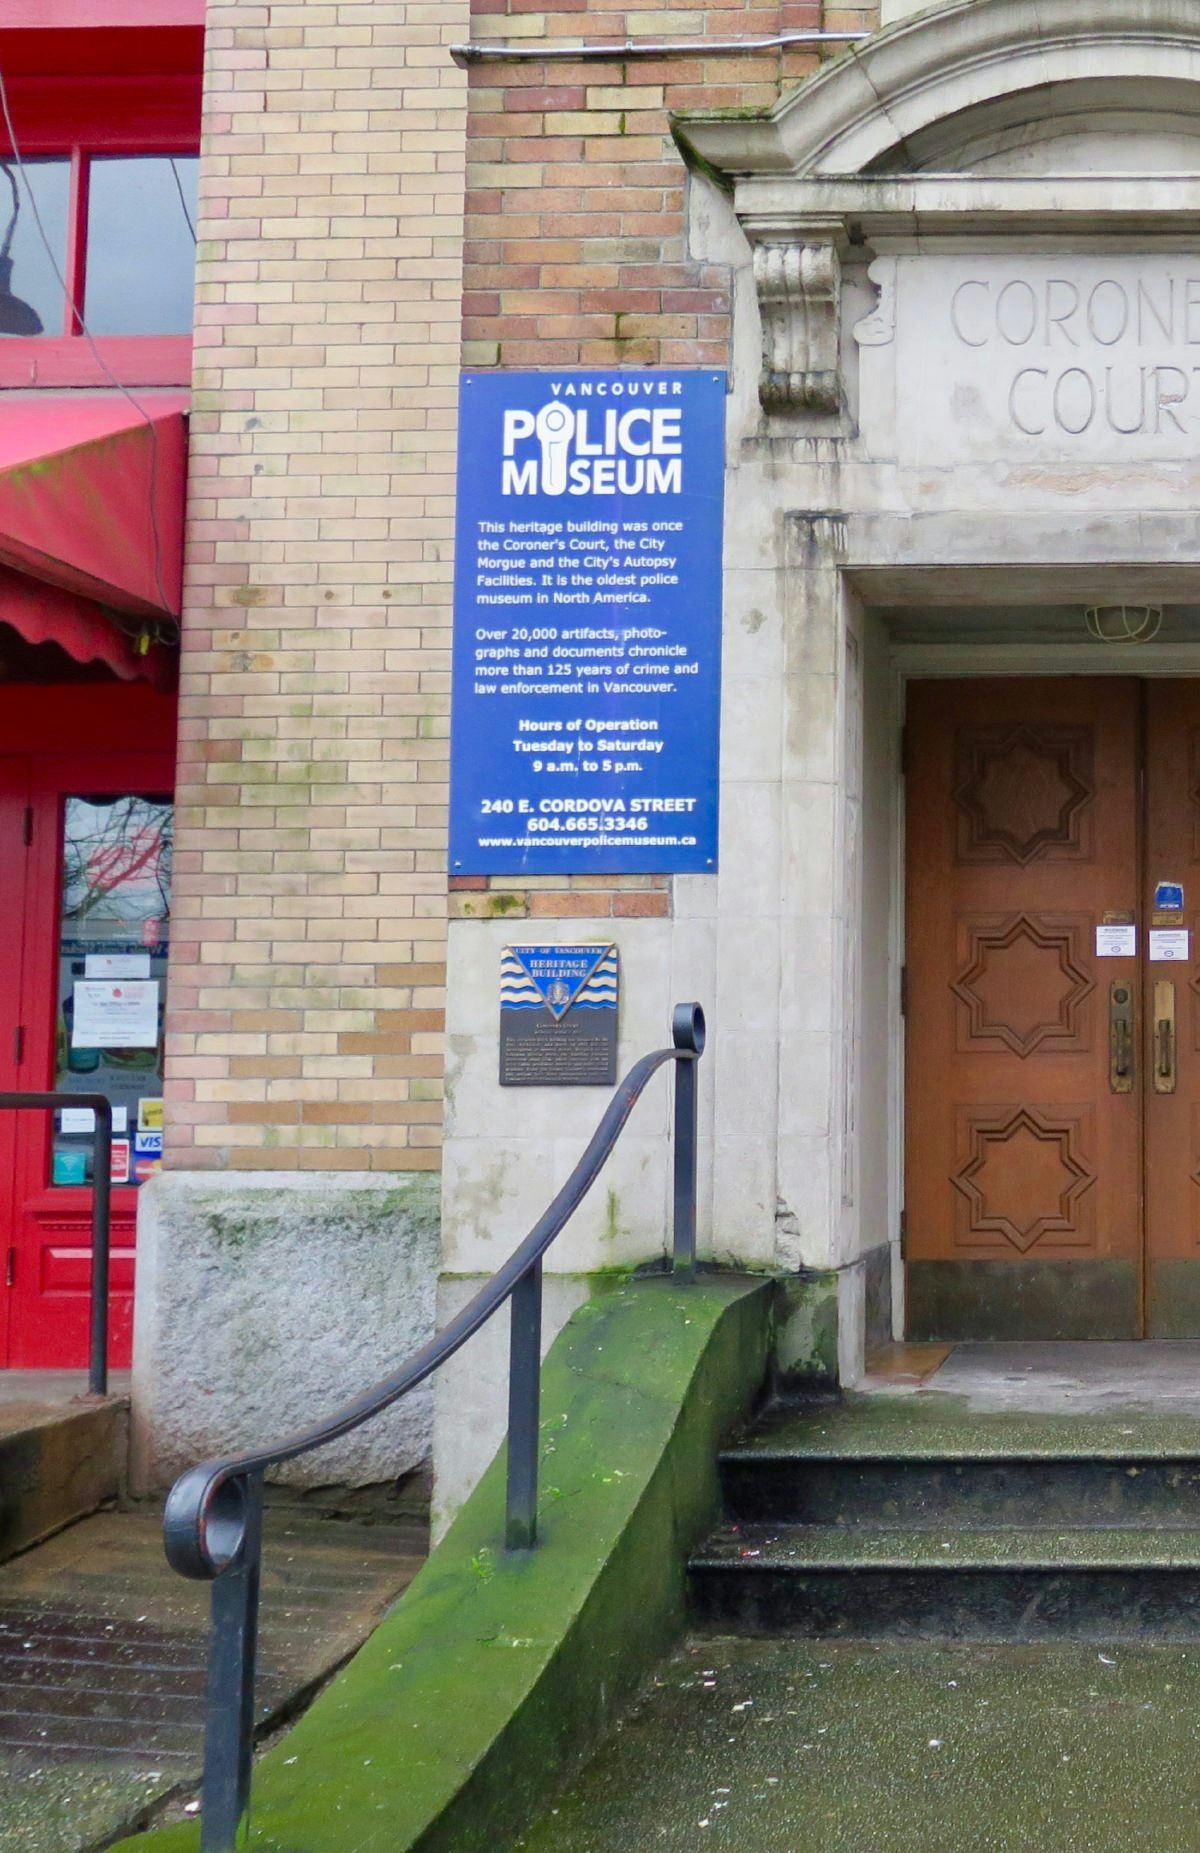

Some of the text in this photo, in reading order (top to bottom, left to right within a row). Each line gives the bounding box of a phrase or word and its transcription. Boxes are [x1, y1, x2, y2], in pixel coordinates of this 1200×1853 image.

[551, 382, 682, 397] VANCOUVER
[503, 400, 682, 457] POLICE
[501, 458, 681, 496] MUSEUM
[478, 520, 683, 536] This heritage building was once
[478, 538, 665, 553] the Coroner's Court, the City
[477, 555, 676, 571] Morgue and the City's Autopsy
[477, 573, 678, 589] Facilities. It is the oldest police
[477, 591, 651, 605] museum in North America.
[476, 628, 667, 642] Over 20,000 artifacts, photo-
[475, 645, 687, 661] graphs and documents chronicle
[475, 663, 698, 678] more than 125 years of crime and
[475, 681, 677, 694] law enforcement in Vancouver.
[519, 719, 658, 734] Hours of Operation
[513, 739, 663, 754] Tuesday to Saturday
[533, 760, 642, 774] 9 a.m. to 5 p.m.
[481, 798, 696, 813] 240 E. CORDOVA STREET
[528, 817, 648, 831] 604.665.3346
[478, 835, 696, 848] www.vancouverpolicemuseum.ca
[530, 959, 588, 968] HERITAGE
[532, 969, 587, 977] BUILDING
[141, 1137, 161, 1147] VIS
